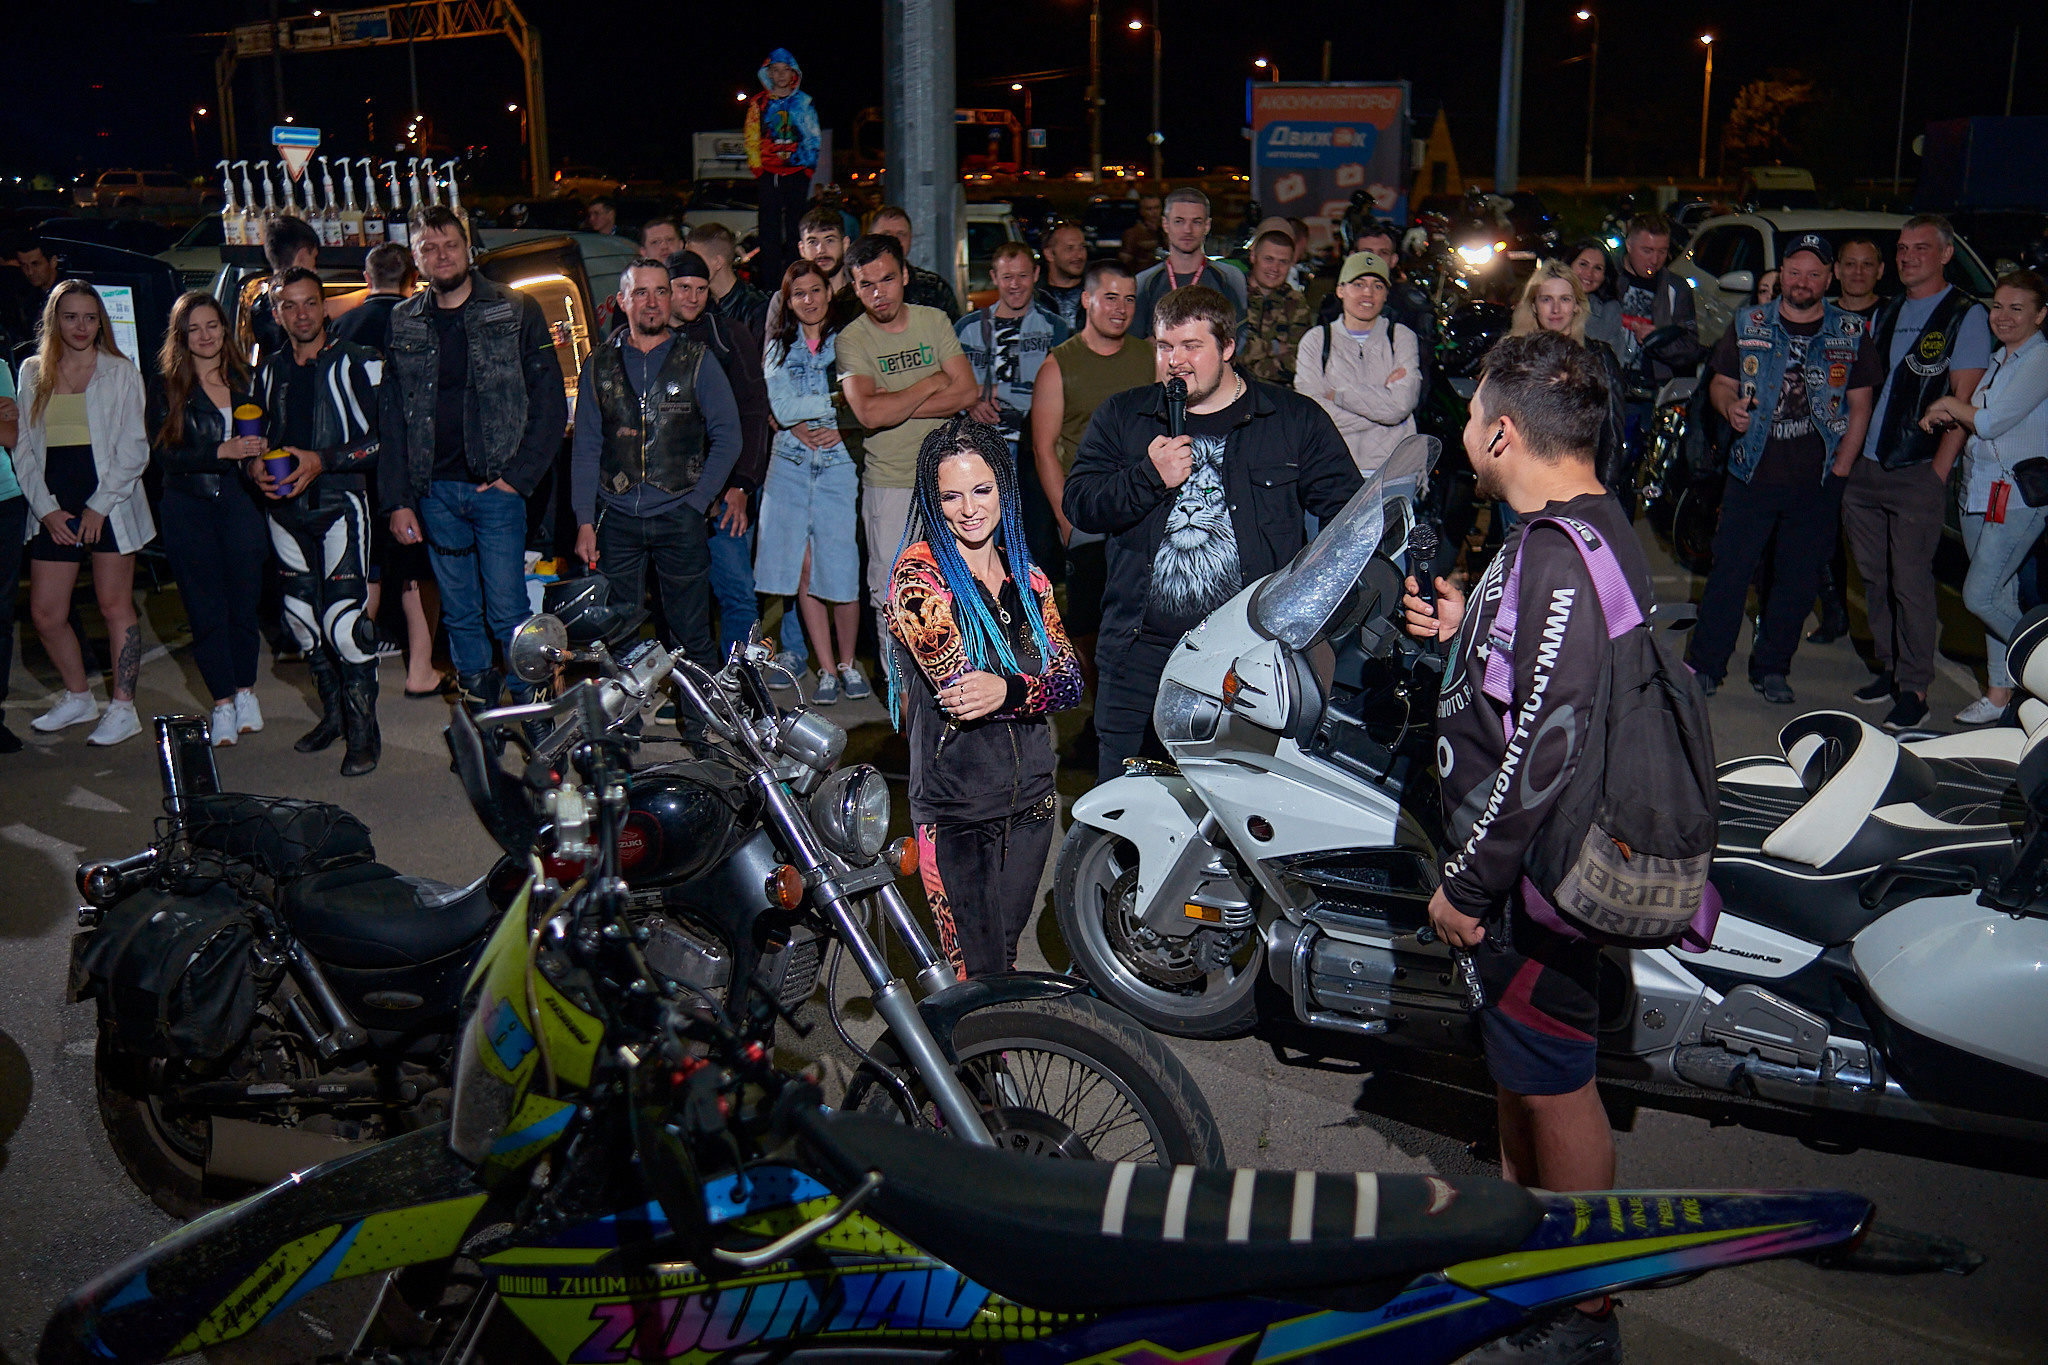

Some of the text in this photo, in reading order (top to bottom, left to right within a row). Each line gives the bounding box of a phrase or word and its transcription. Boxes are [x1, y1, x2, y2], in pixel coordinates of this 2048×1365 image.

[879, 341, 932, 372] perfect
[1584, 860, 1702, 910] BRIDE
[1710, 944, 1782, 964] OLDWING
